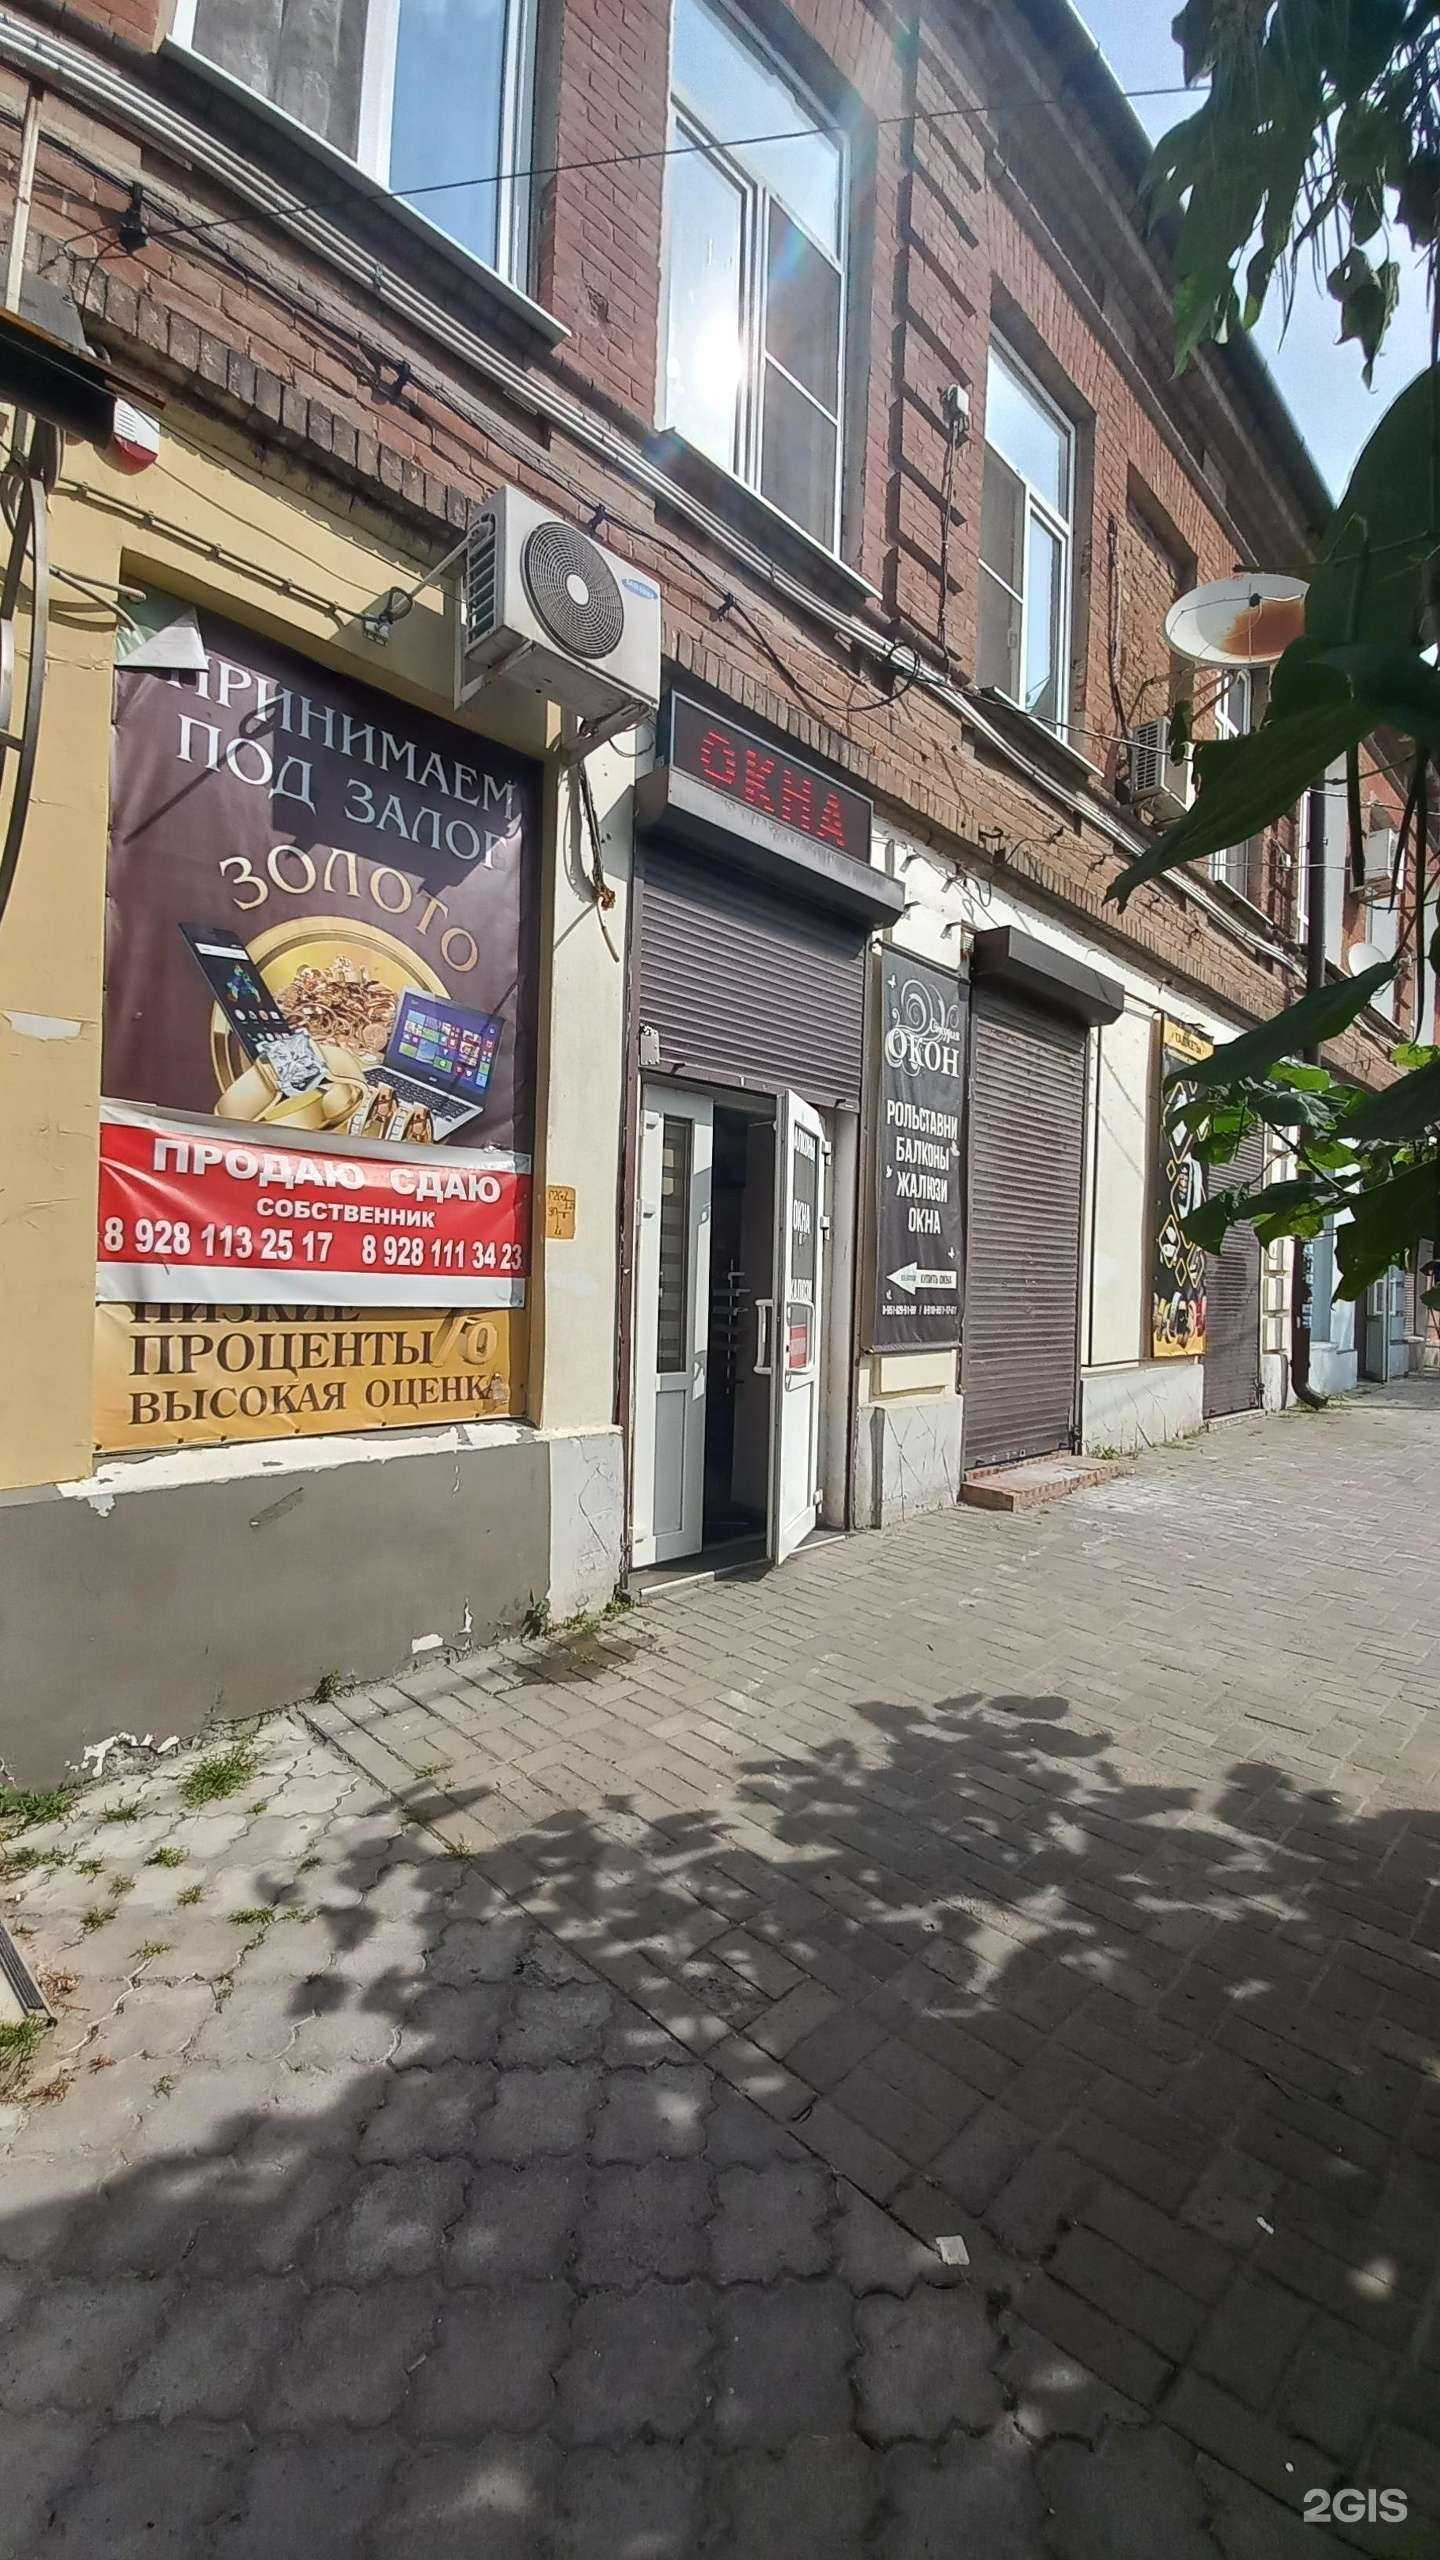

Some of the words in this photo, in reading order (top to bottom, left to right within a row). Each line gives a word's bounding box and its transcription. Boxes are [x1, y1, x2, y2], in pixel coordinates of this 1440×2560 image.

[177, 714, 317, 815] ПОД
[343, 778, 508, 870] ЗАЛОГ
[698, 727, 848, 847] ОКНА
[219, 842, 480, 974] ЗОЛОТО
[885, 1028, 960, 1078] ОКОН
[886, 1098, 959, 1141] РОЛЬСТАВНИ
[152, 1137, 366, 1190] ПРОДАЮ
[389, 1167, 502, 1204] СДАЮ
[895, 1140, 950, 1172] БАЛКОНЫ
[896, 1172, 948, 1204] ЖАЛЮЗИ
[256, 1196, 436, 1228] СОБСТВЕННИК
[793, 1199, 810, 1234] ОКНА
[908, 1209, 942, 1236] ОКНА
[103, 1216, 124, 1253] 8
[134, 1217, 192, 1256] 928
[201, 1222, 254, 1260] 113
[259, 1226, 294, 1262] 25
[302, 1229, 334, 1264] 17
[361, 1237, 377, 1266] 8
[382, 1237, 424, 1268] 928
[430, 1238, 465, 1269] 111
[471, 1241, 497, 1271] 34
[499, 1242, 523, 1271] 23
[129, 1330, 433, 1381] ПРОЦЕНТЫ
[129, 1381, 347, 1425] ВЫСОКАЯ
